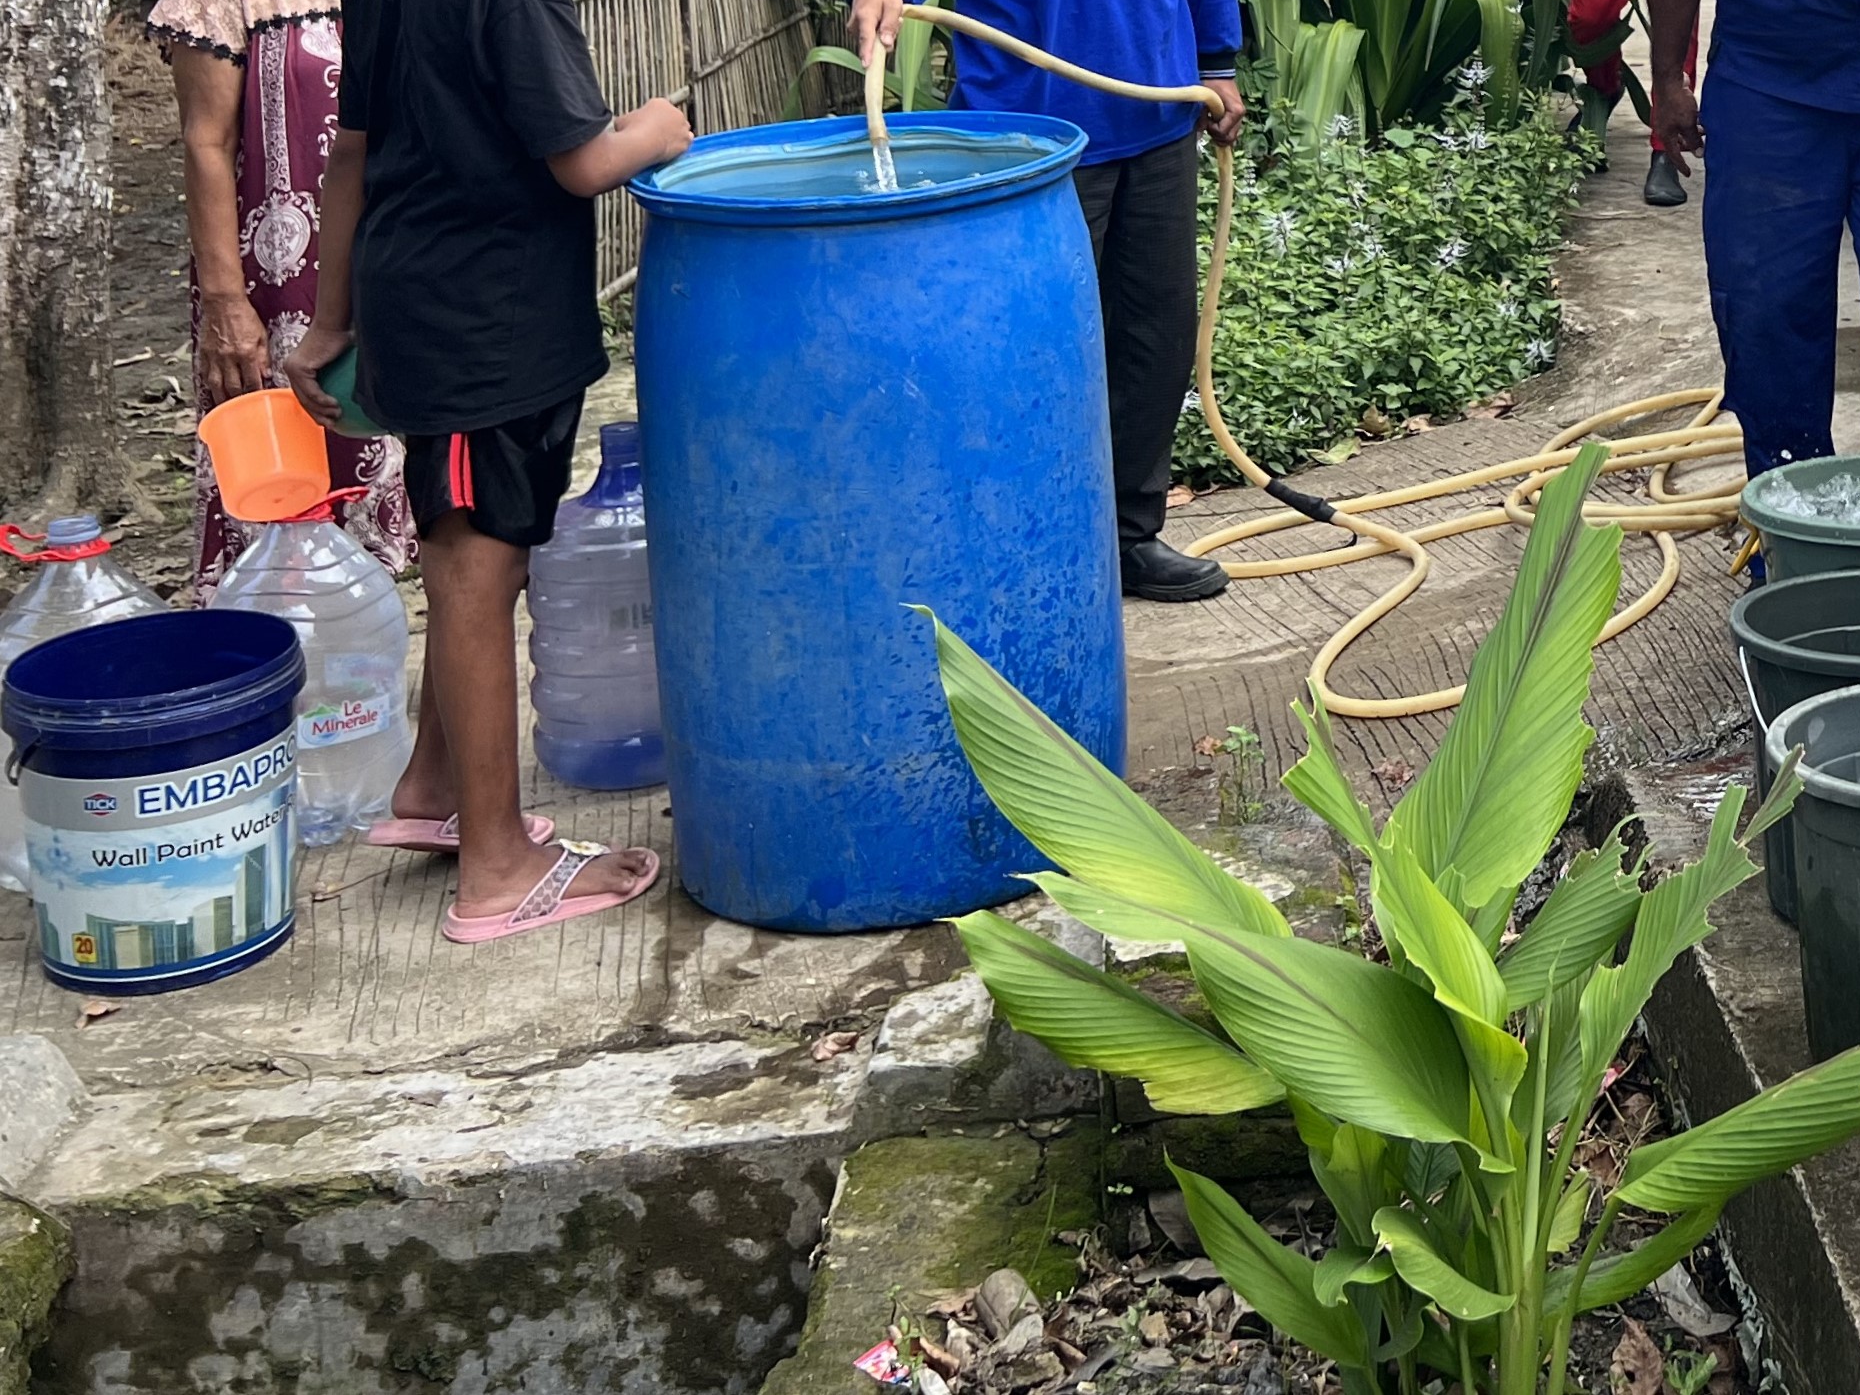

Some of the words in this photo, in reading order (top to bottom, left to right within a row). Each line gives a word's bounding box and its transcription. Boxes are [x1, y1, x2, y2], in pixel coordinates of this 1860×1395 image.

[343, 701, 362, 717] Le
[311, 709, 379, 736] Minerale
[84, 800, 117, 810] TICK
[91, 847, 148, 867] Wall
[156, 833, 225, 863] Paint
[75, 936, 94, 955] 20
